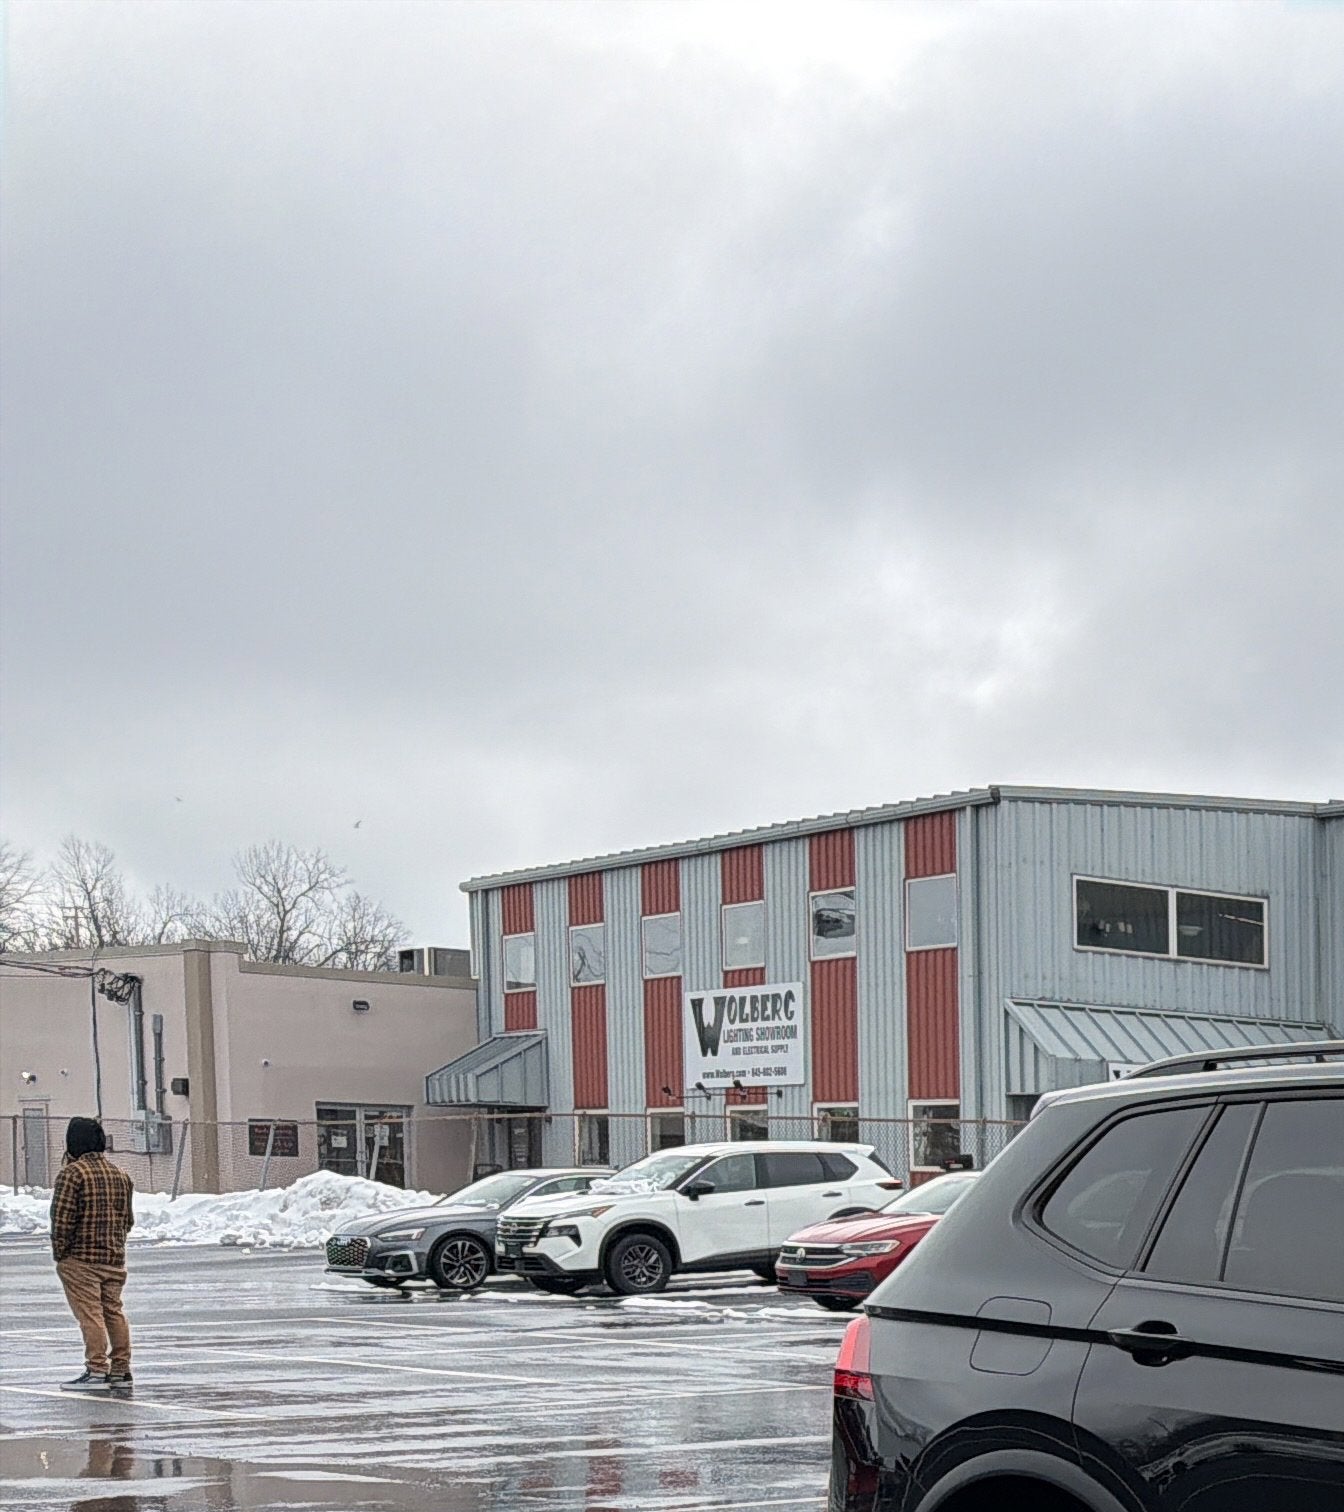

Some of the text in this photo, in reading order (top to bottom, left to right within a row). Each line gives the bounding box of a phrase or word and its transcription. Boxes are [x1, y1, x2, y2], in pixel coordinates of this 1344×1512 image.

[690, 989, 796, 1057] WOLBERG
[723, 1024, 798, 1043] LIGHTING SHOWROOM
